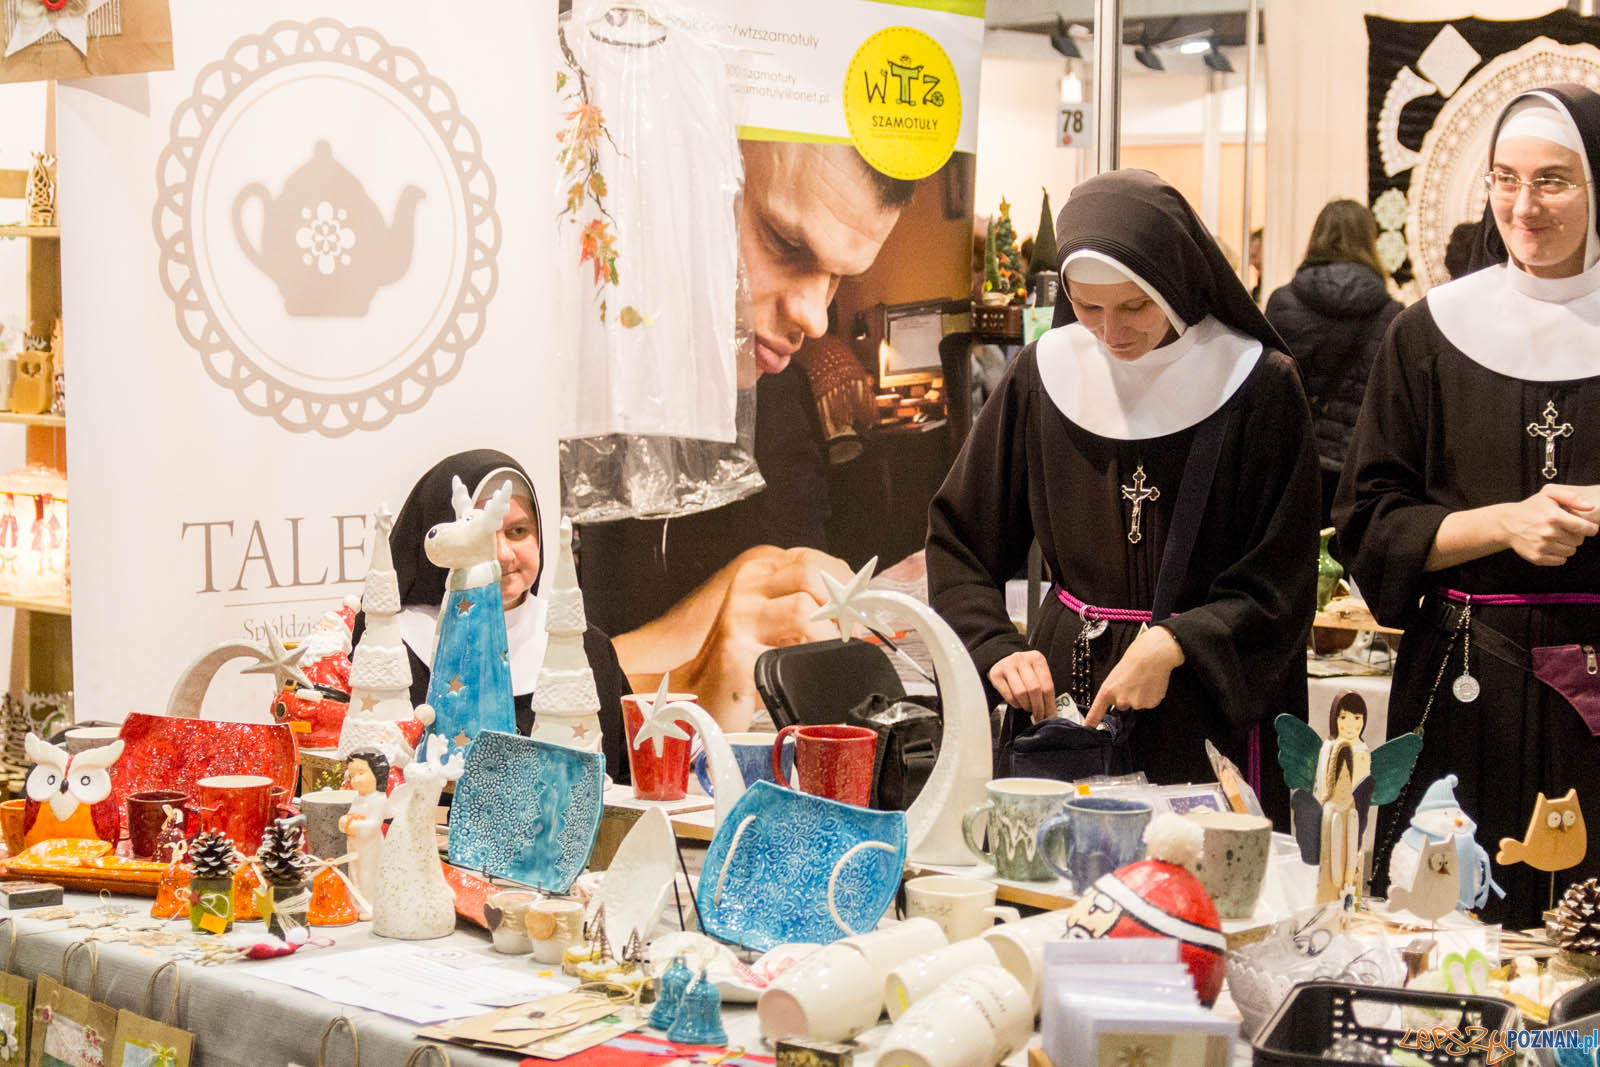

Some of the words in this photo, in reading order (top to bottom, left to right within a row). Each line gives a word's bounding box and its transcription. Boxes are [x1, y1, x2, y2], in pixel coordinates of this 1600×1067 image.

[864, 58, 945, 108] WTZ
[872, 115, 939, 131] SZAMOTUŁY
[1061, 110, 1083, 133] 78
[181, 514, 367, 594] TALE
